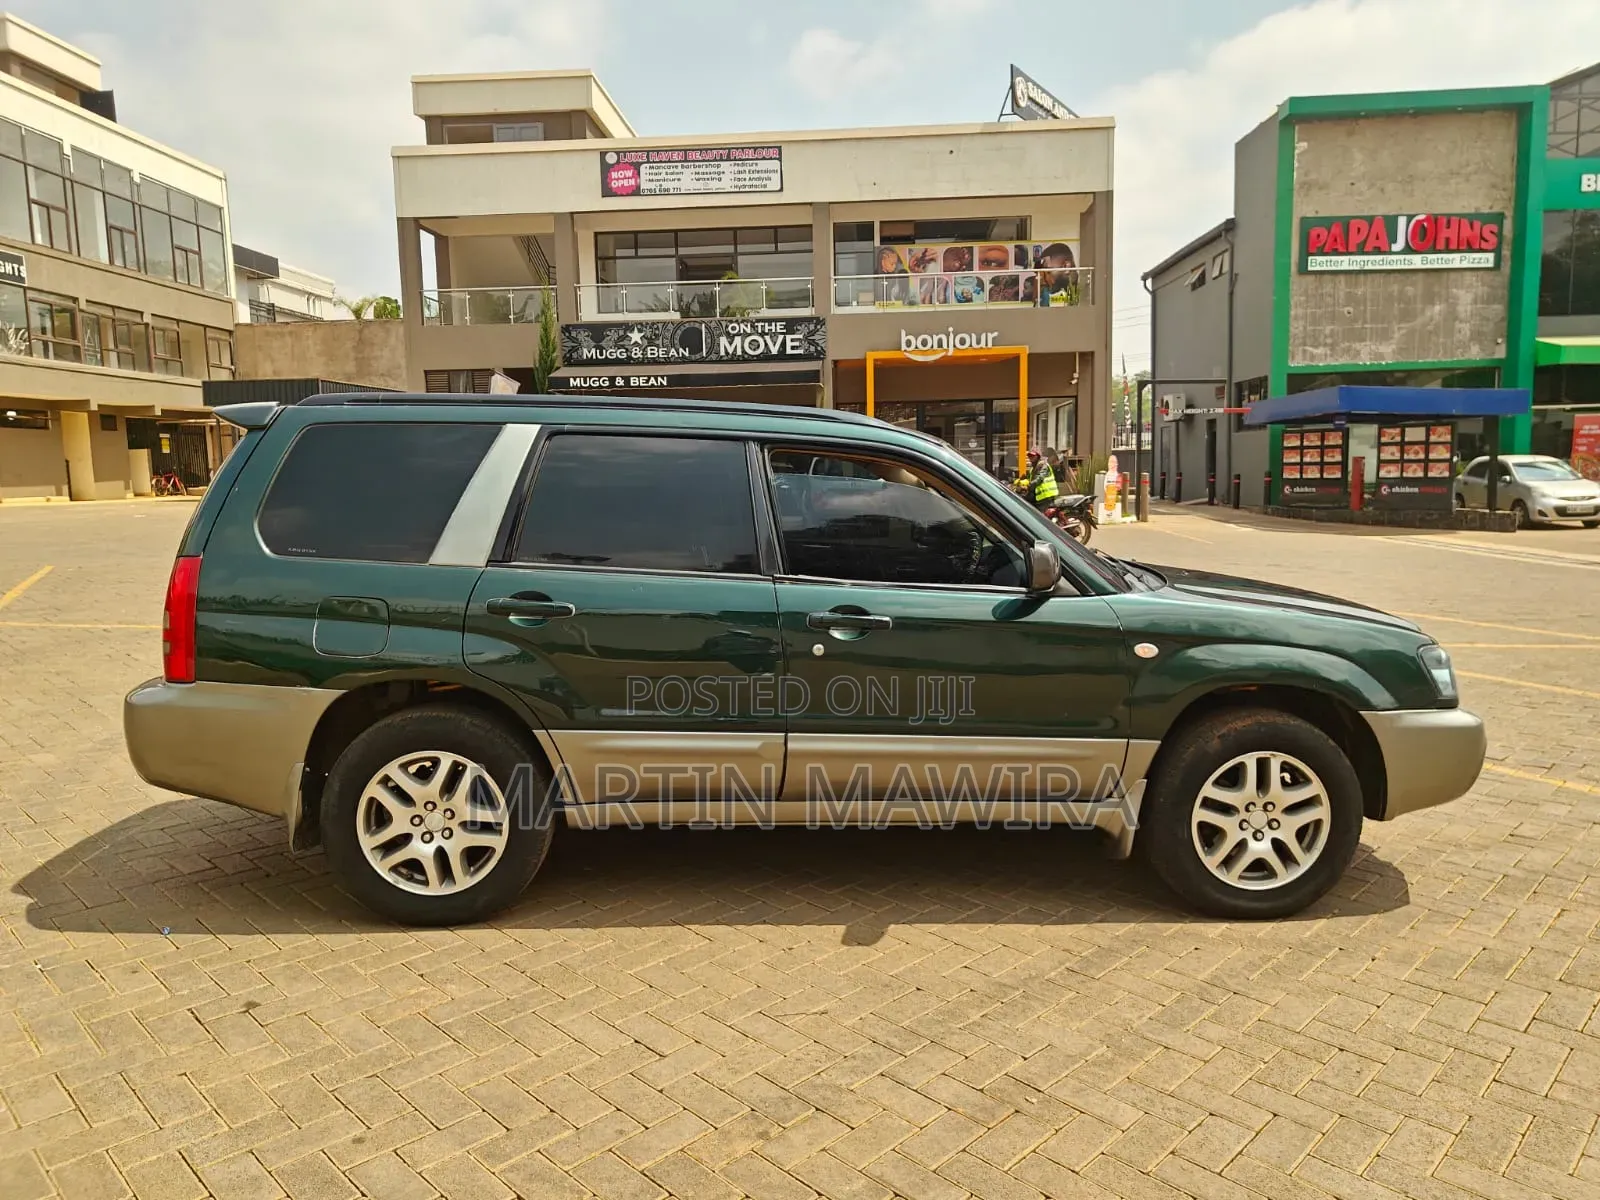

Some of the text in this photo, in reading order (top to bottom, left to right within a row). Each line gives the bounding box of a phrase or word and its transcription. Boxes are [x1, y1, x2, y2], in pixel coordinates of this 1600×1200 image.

[649, 151, 684, 161] HAVEN
[687, 150, 728, 160] BEAUTY
[730, 148, 779, 159] PARLOUR
[612, 170, 633, 178] NOW
[611, 179, 635, 188] OPEN
[1309, 258, 1345, 269] Better
[1348, 256, 1416, 269] Ingredients.
[1420, 255, 1454, 265] Better
[728, 322, 787, 334] ON THE
[720, 335, 804, 356] MOVE
[901, 326, 999, 356] bonjour
[631, 347, 644, 359] &
[569, 376, 667, 388] MUGG & BEAN
